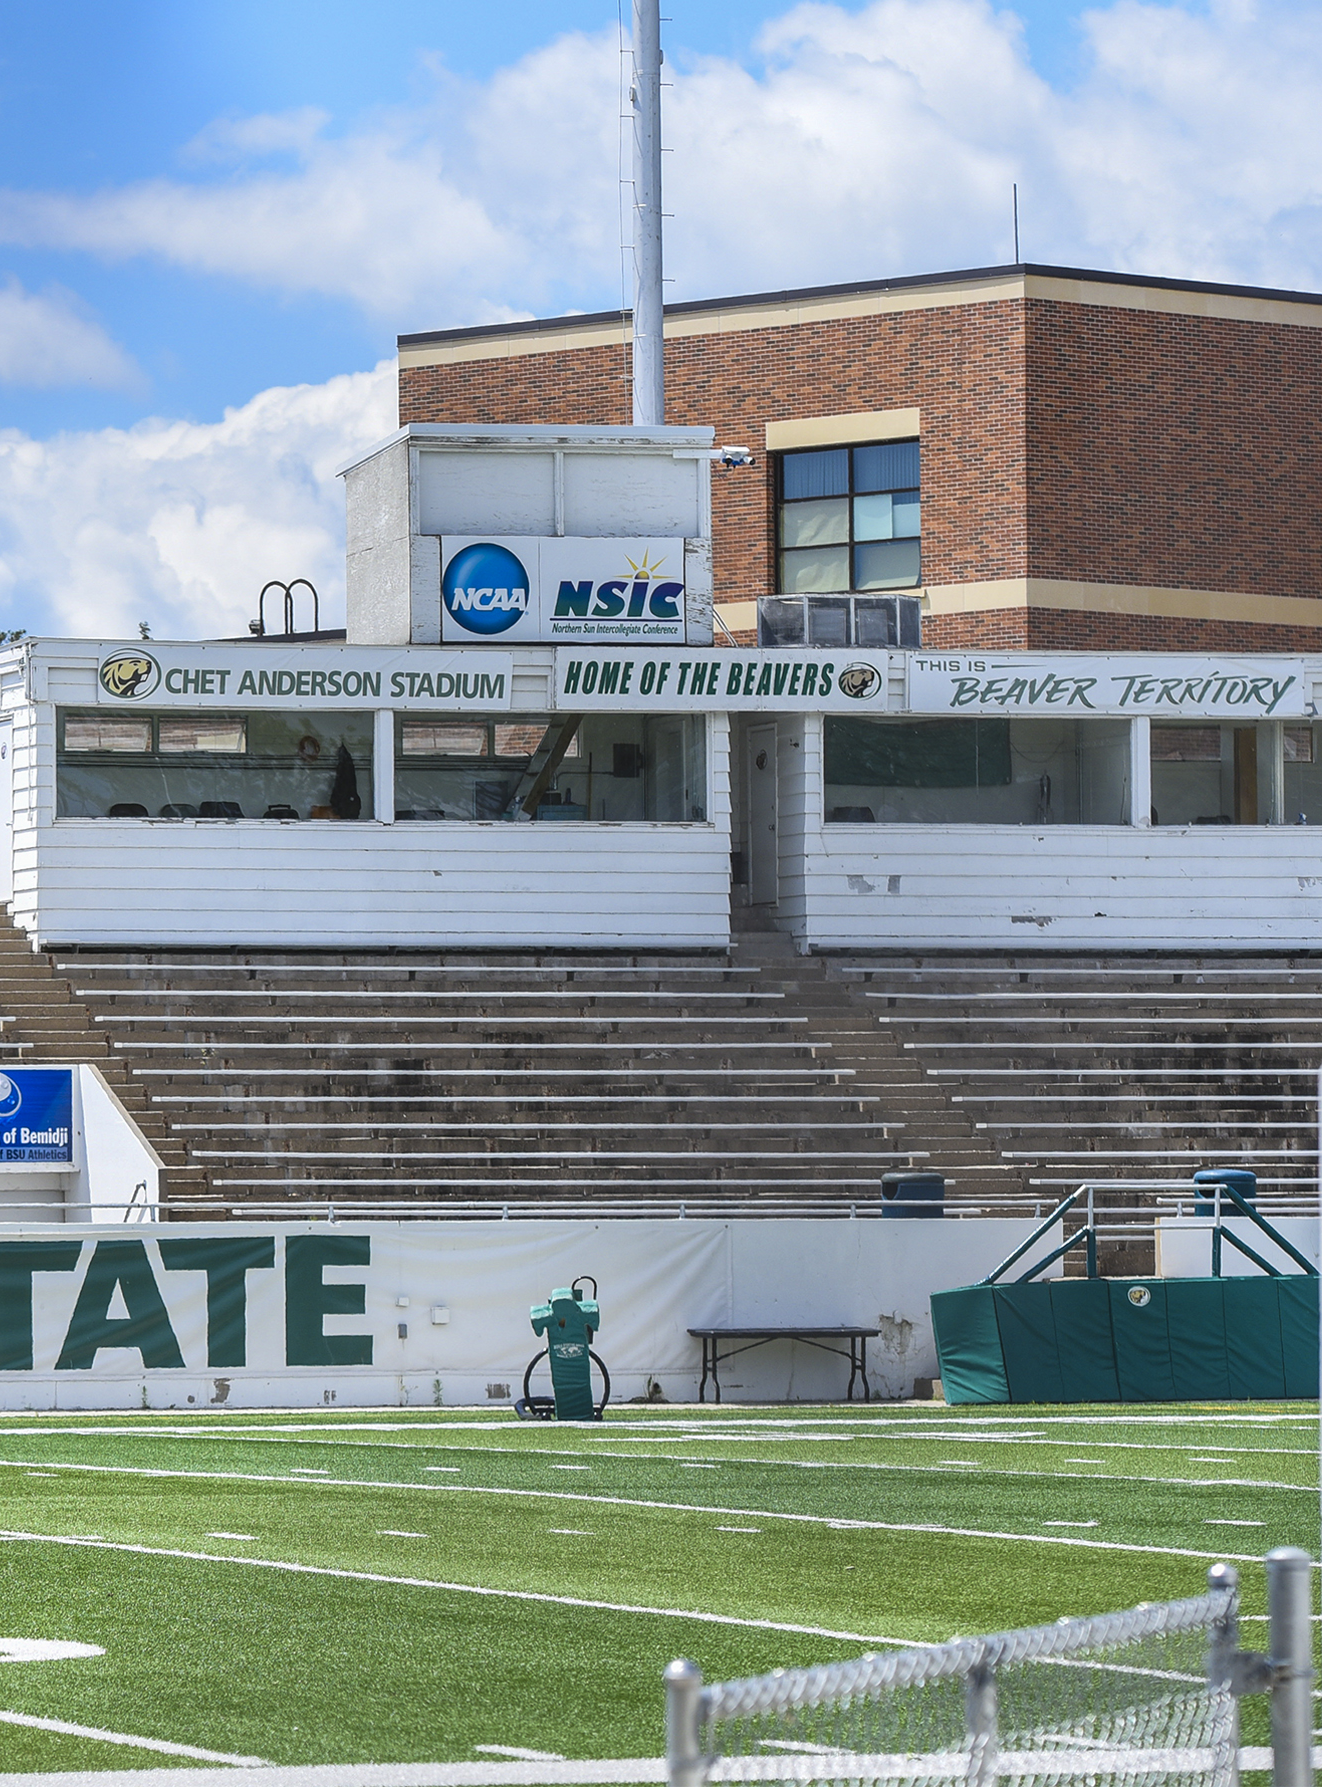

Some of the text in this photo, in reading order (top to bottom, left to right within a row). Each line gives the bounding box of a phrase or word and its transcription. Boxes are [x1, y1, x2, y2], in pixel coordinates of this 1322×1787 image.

[450, 587, 527, 612] NCAA
[553, 580, 685, 618] NSIC
[551, 622, 678, 637] Northern Sun Intercollegiate Conference
[563, 660, 835, 697] HOME OF THE BEAVERS
[915, 660, 987, 672] THIS IS
[164, 669, 505, 699] CHET ANDERSON STADIUM
[950, 671, 1297, 715] BEAVER TERRITORY
[2, 1127, 17, 1144] of
[20, 1127, 69, 1147] Bemidji
[6, 1149, 26, 1160] BSU
[28, 1149, 67, 1160] Athletics
